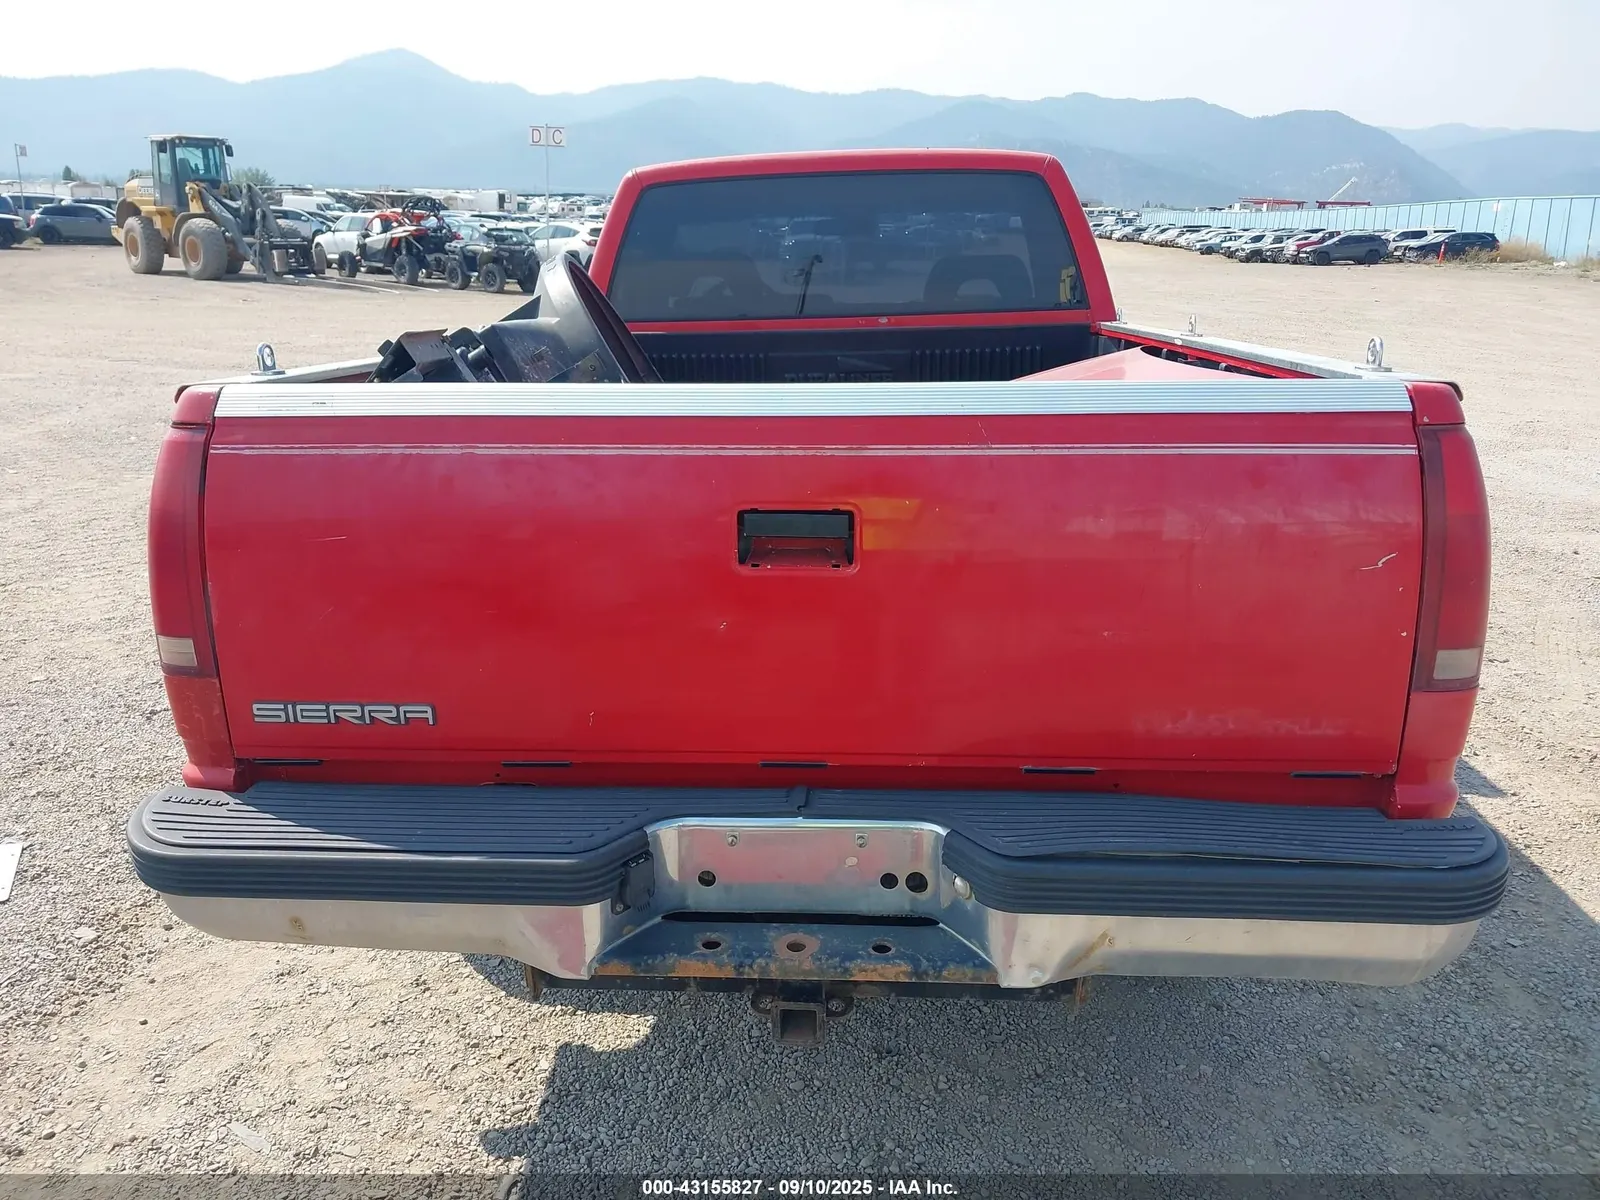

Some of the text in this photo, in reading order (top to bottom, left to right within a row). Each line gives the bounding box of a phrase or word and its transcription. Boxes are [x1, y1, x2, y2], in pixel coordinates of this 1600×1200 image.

[531, 128, 563, 145] D C
[252, 702, 436, 726] SIERRA
